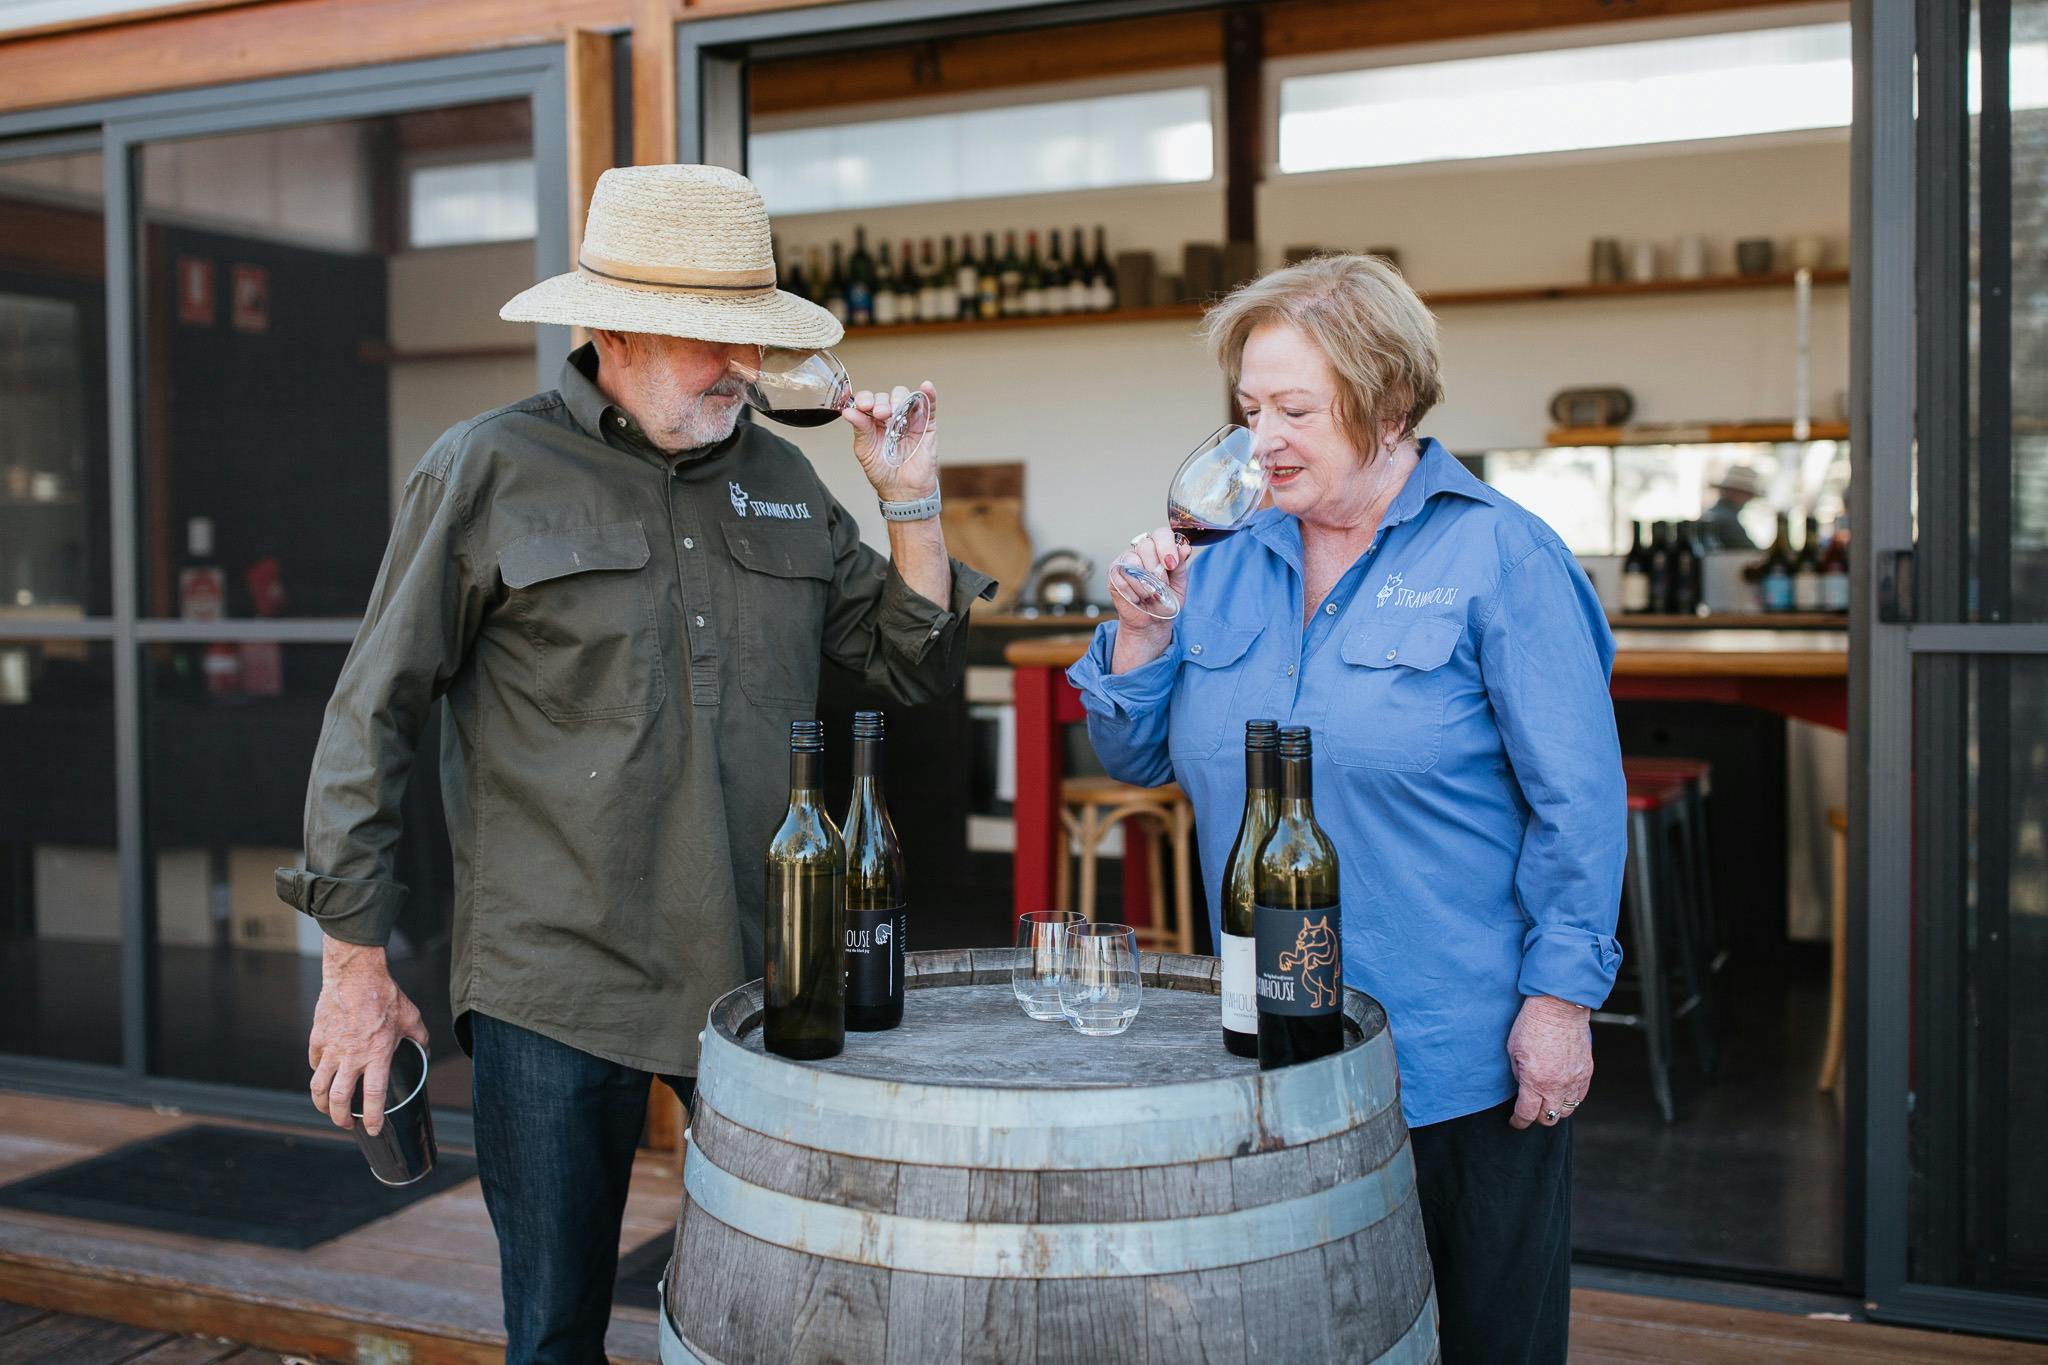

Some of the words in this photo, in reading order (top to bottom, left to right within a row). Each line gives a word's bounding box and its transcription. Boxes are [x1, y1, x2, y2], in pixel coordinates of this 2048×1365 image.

[749, 500, 812, 519] STRAWHOUSE
[1394, 588, 1459, 608] STRAWHOUSE
[845, 929, 870, 948] OUSE
